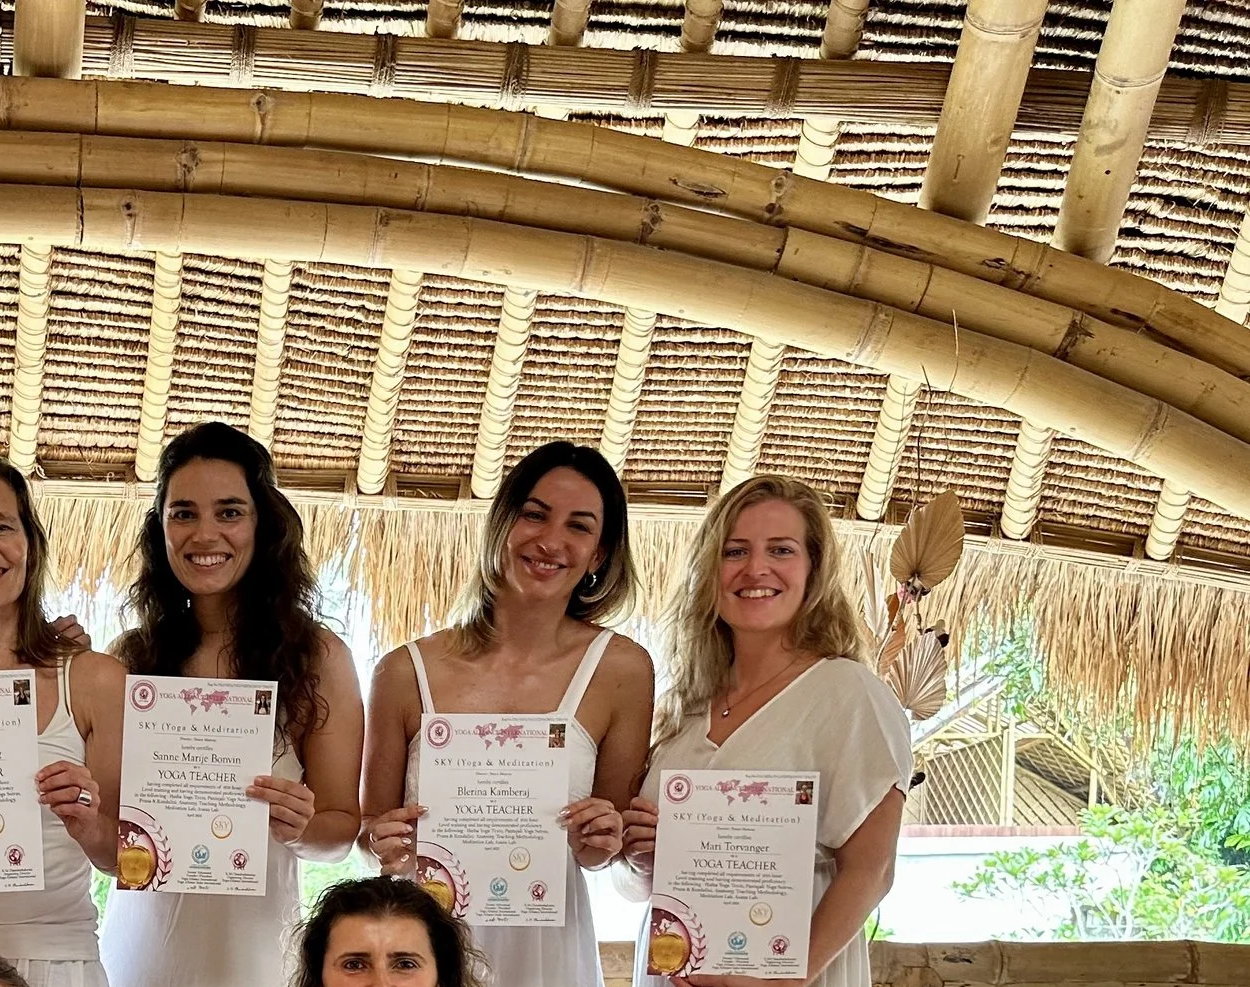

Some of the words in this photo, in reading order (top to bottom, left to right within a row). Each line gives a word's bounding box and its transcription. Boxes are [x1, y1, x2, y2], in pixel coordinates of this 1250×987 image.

[162, 723, 186, 732] (Yoga
[203, 725, 259, 735] Meditation)
[153, 752, 179, 761] Sanne
[182, 753, 208, 764] Marije
[211, 754, 241, 764] Bonvin
[457, 759, 482, 767] (Yoga
[158, 770, 187, 780] YOGA
[190, 771, 237, 782] TEACHER
[458, 787, 487, 796] Blerina
[490, 787, 530, 798] Kamberaj
[455, 806, 483, 814] YOGA
[486, 805, 533, 814] TEACHER
[697, 814, 723, 822] (Yoga
[741, 815, 800, 823] Meditation)
[701, 841, 722, 851] Mari
[724, 842, 770, 853] Torvanger
[693, 859, 722, 868] YOGA
[726, 860, 777, 870] TEACHER
